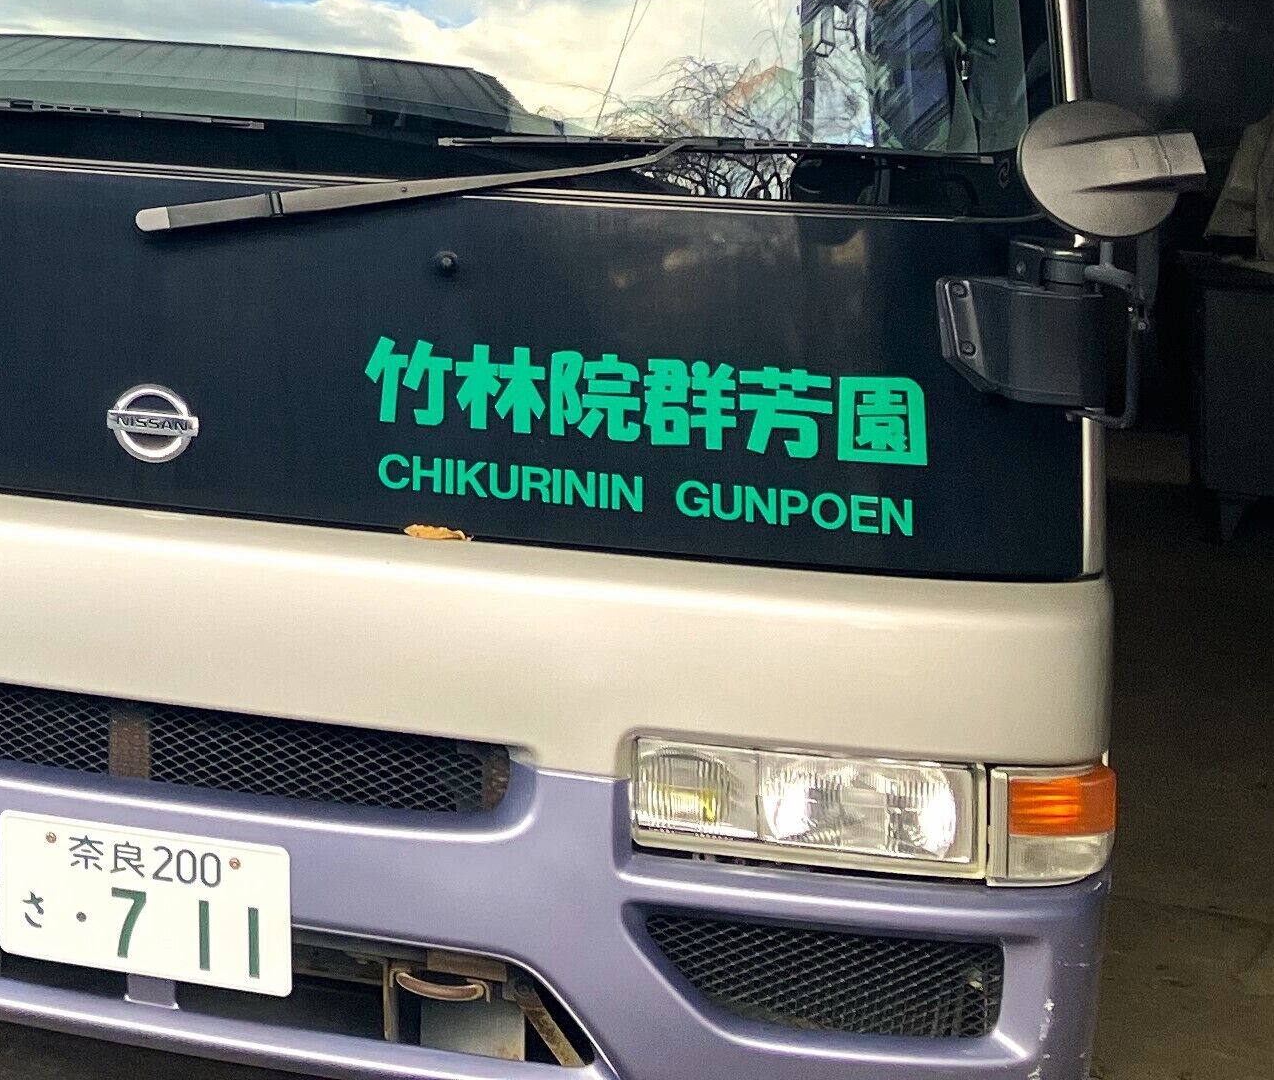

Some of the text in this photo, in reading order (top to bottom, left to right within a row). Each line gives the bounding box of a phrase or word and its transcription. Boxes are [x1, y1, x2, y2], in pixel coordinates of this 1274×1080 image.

[116, 416, 188, 431] NISSAN
[364, 336, 927, 466] 竹林院群芳園
[378, 453, 913, 536] CHIKURININ GUNPOEN
[22, 891, 45, 928] さ
